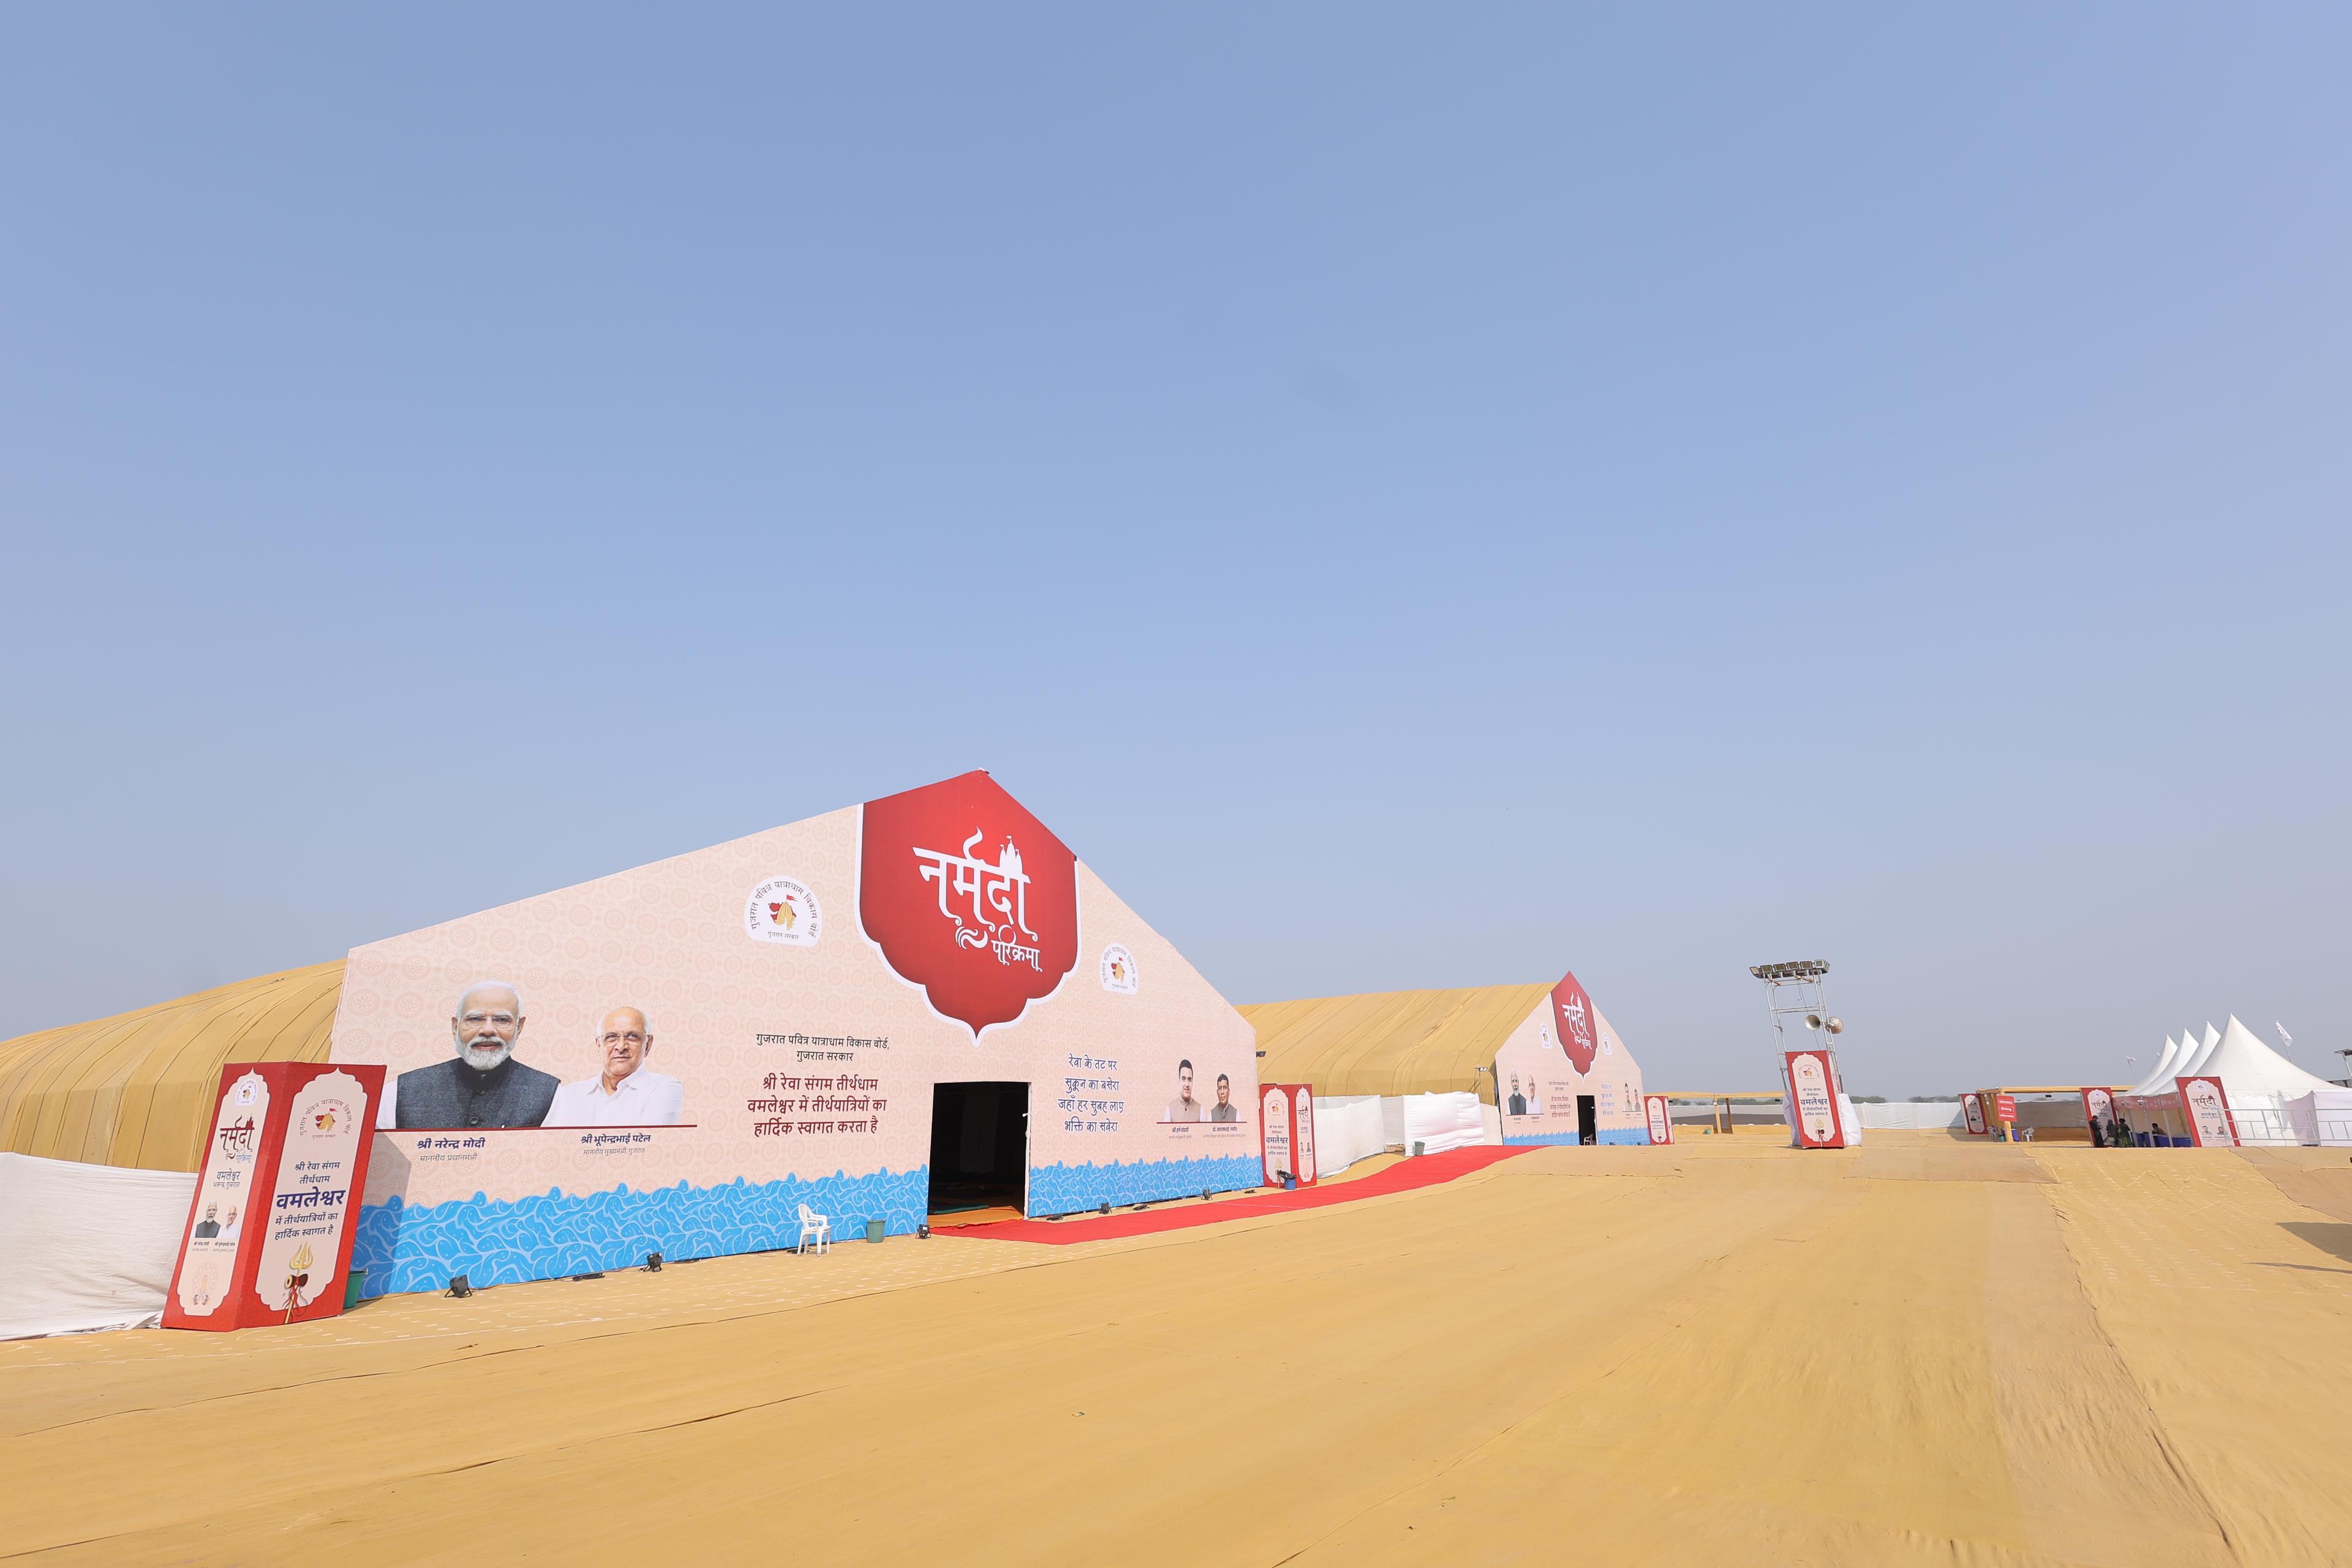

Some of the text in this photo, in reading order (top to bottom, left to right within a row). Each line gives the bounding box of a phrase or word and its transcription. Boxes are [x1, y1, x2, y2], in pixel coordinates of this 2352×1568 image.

[990, 924, 1042, 973] परिक्रमा
[756, 1033, 786, 1046] गुजरात
[788, 1033, 809, 1045] पवित्र
[811, 1036, 845, 1047] यात्राधाम
[846, 1036, 872, 1049] विकास
[796, 1050, 854, 1063] गुजरात सरकार
[1068, 1052, 1117, 1071] रेवा के तट पर
[763, 1072, 879, 1091] श्री रेवा संगम तीर्थधाम
[1065, 1077, 1120, 1093] सुकून का बसेरा
[747, 1095, 888, 1114] वमलेश्वर में तीर्थयात्रियों का
[1058, 1094, 1125, 1116] जहाँ हर सुबह लाए
[1800, 1096, 1828, 1106] वमलेश्वर
[754, 1115, 879, 1137] हार्दिक स्वागत करता है
[1065, 1115, 1118, 1133] भक्ति का सवेरा
[417, 1136, 486, 1150] श्री नरेन्द्र मोदी
[581, 1133, 651, 1147] श्री भूपेन्द्रभाई पटेल
[1265, 1134, 1289, 1144] वमलेश्वर
[295, 1160, 341, 1171] श्री रेवा संगम
[420, 1153, 446, 1162] माननीय
[299, 1174, 331, 1184] तीर्थधाम
[276, 1186, 347, 1210] वमलेश्वर
[284, 1212, 327, 1224] तीर्थयात्रियों
[274, 1224, 334, 1241] हार्दिक स्वागत है
